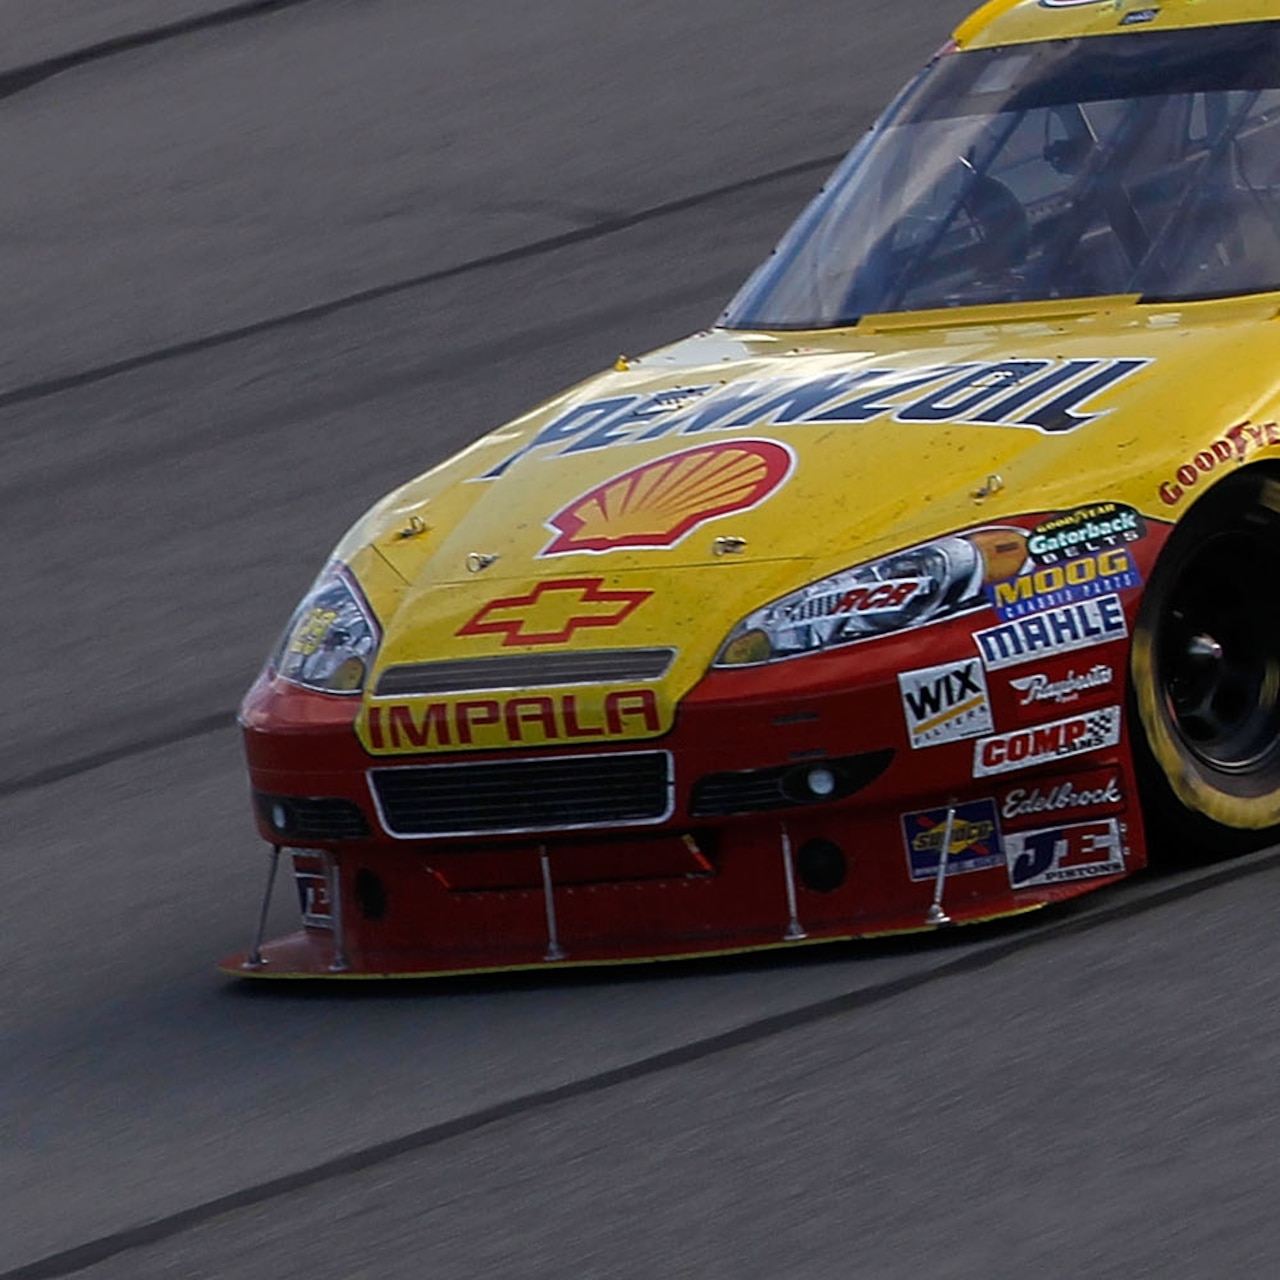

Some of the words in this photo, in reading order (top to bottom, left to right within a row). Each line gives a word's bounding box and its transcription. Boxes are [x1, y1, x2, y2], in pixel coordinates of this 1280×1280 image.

[464, 357, 1156, 483] PENNZOIL
[1028, 512, 1138, 554] Gatorback
[1042, 531, 1139, 564] BELTS
[995, 548, 1130, 607] MOOG
[1005, 590, 1073, 618] CHASSIS
[1083, 574, 1134, 596] PARTS
[977, 596, 1125, 663] MAHLE
[905, 661, 981, 720] WIX
[367, 689, 660, 750] IMPALA
[914, 705, 987, 745] FILTERS
[983, 720, 1087, 767] COMP
[1002, 777, 1122, 819] Edelbrock
[1013, 823, 1110, 884] JE
[1045, 862, 1121, 881] PISTONS
